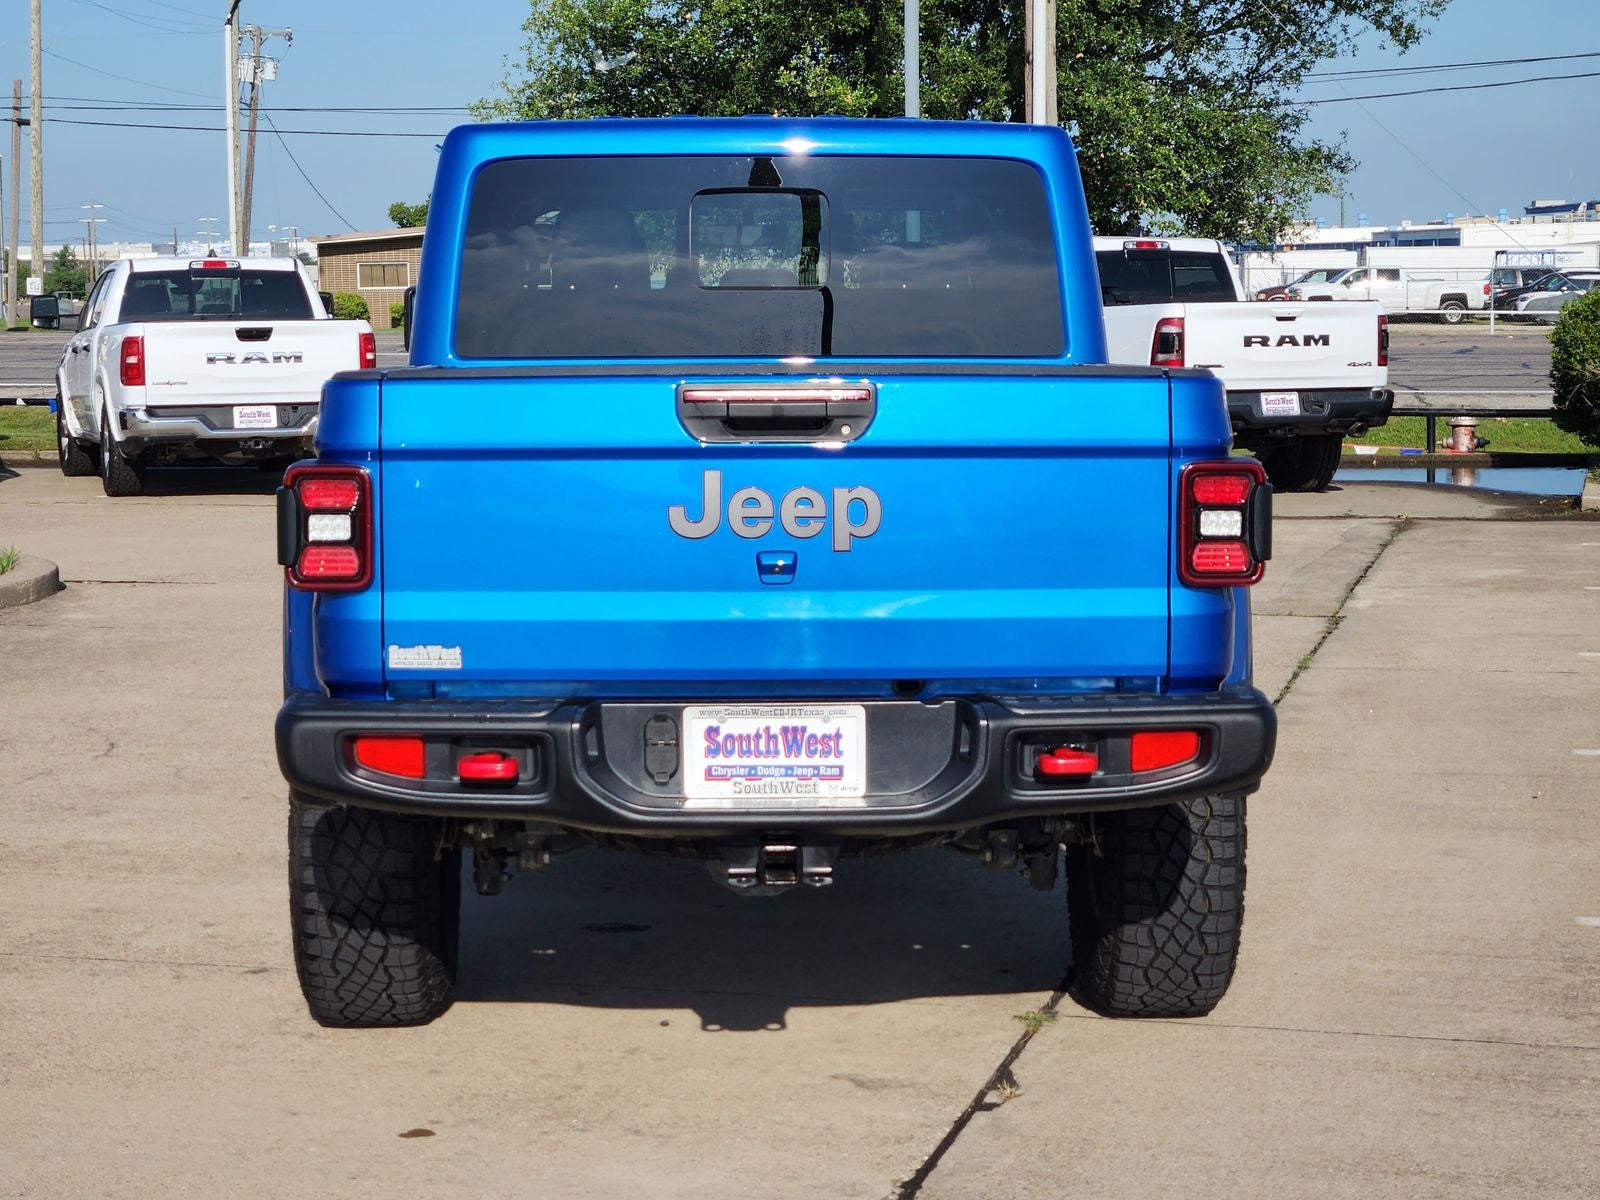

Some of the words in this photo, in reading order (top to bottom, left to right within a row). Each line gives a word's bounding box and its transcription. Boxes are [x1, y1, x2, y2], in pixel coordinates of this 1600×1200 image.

[1243, 334, 1330, 348] RAM
[206, 351, 303, 365] RAM
[668, 469, 883, 552] Jeep
[704, 725, 844, 759] SouthWest
[711, 766, 750, 777] Chrysler
[757, 766, 786, 777] Dodge
[792, 766, 814, 777] Jeep
[819, 766, 840, 776] Ram
[733, 781, 820, 795] SouthWest
